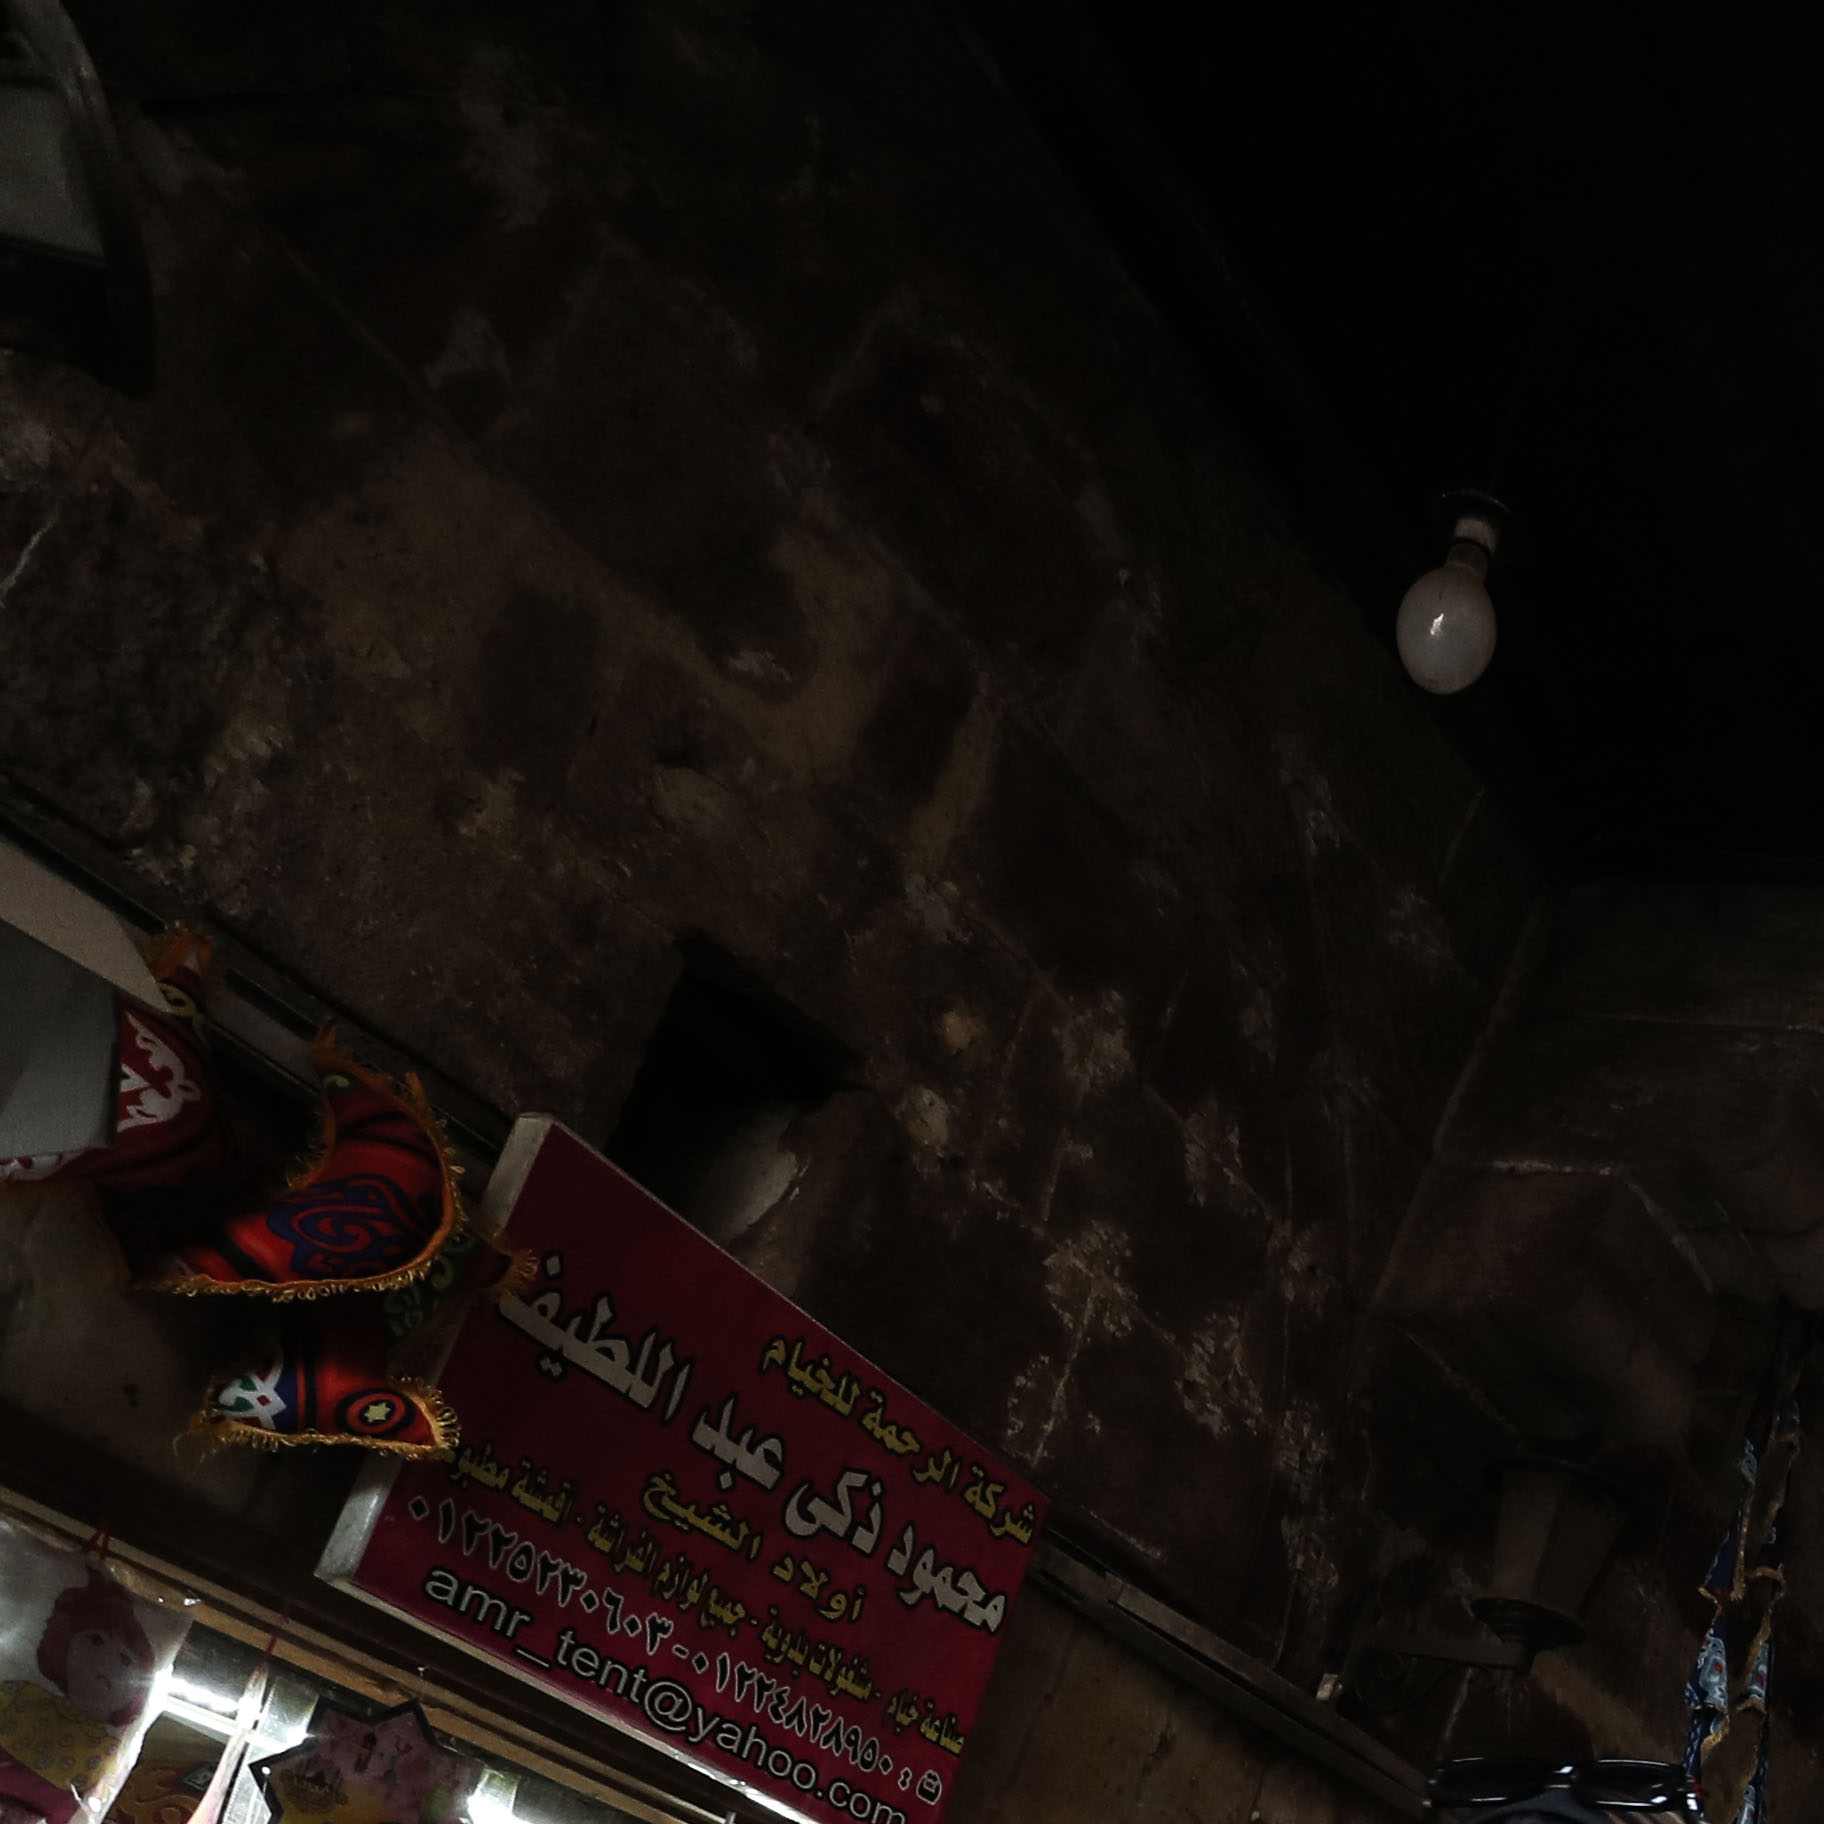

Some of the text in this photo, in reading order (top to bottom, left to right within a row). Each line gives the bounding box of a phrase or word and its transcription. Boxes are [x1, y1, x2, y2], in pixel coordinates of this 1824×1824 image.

[499, 1248, 1006, 1633] محمود ذكى عبد اللطيف
[762, 1339, 1034, 1544] شركة الرحمة للخيام
[642, 1473, 863, 1620] أولاد الشيخ
